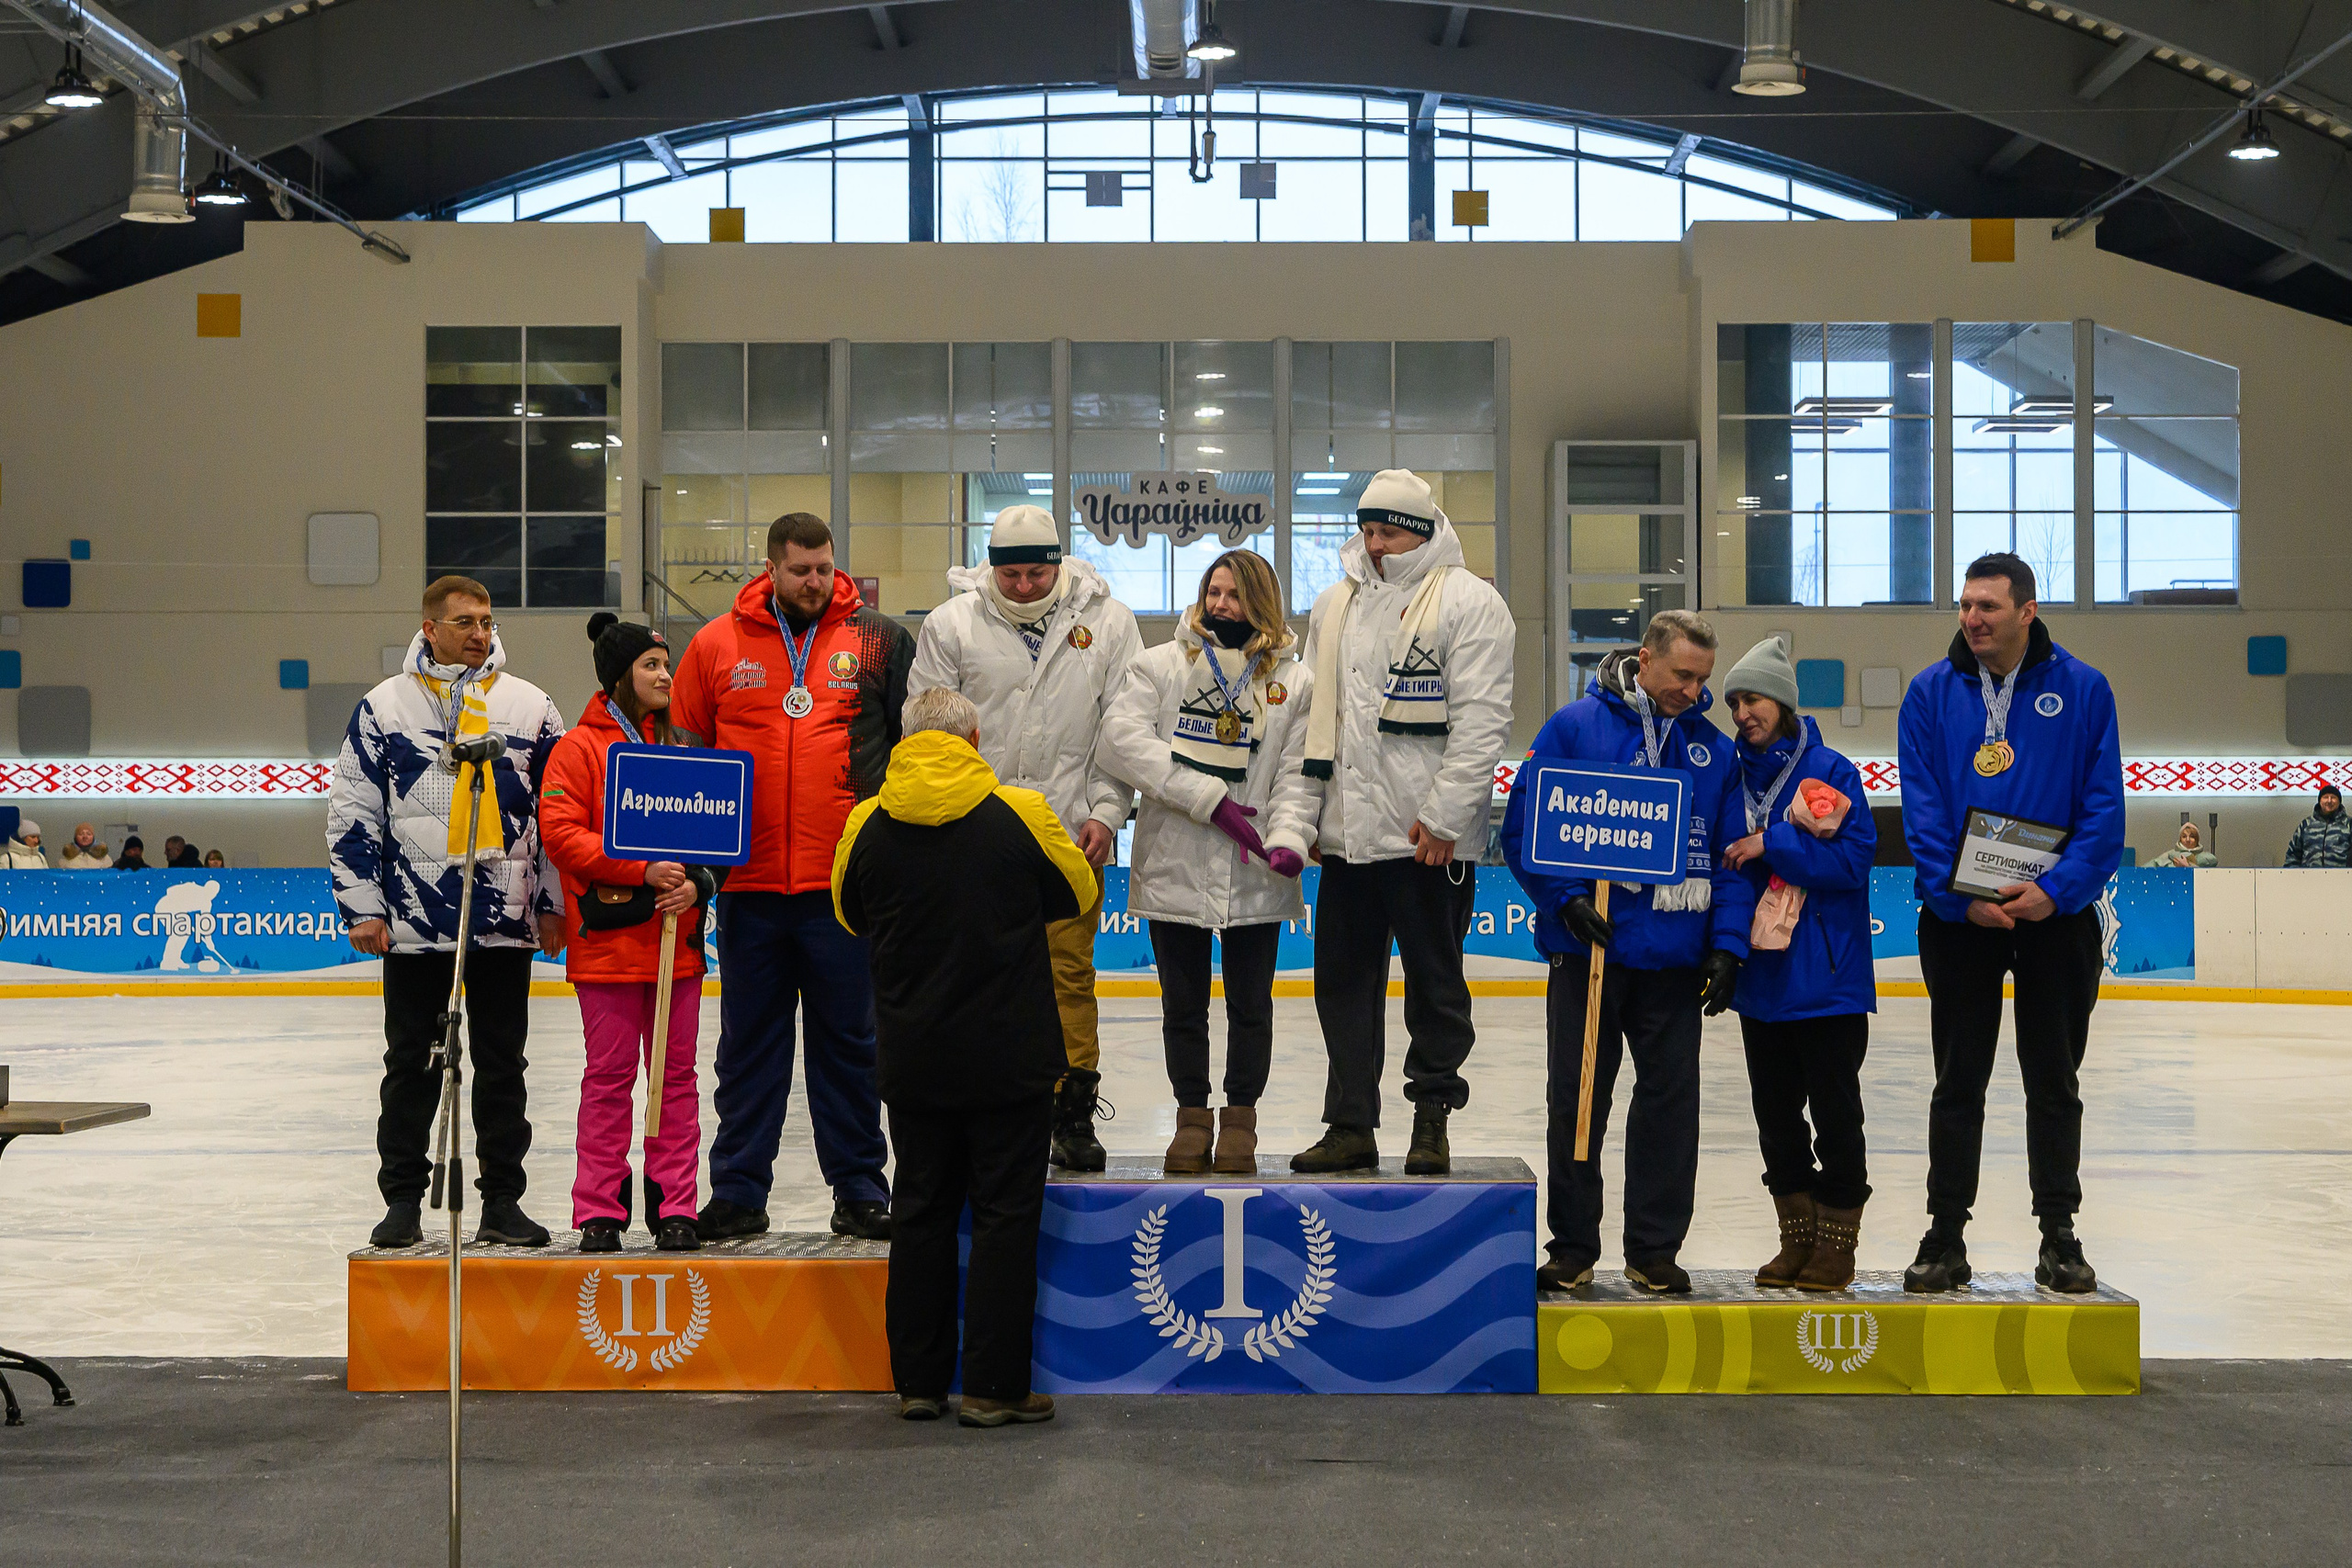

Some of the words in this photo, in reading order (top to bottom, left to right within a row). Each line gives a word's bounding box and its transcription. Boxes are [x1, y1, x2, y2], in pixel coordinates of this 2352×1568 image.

[1139, 479, 1207, 494] КАФЕ
[1082, 493, 1265, 540] Чараўніца
[1388, 514, 1430, 532] БЕЛАРУСЬ
[828, 680, 858, 690] BELARUS
[1178, 716, 1214, 735] БЕЛЫЕ
[621, 786, 736, 818] Агрохолдинг
[1547, 785, 1669, 822] Академия
[1559, 823, 1654, 852] сервиса
[1974, 851, 2045, 875] СЕРТИФИКАТ
[0, 906, 122, 937] имняя
